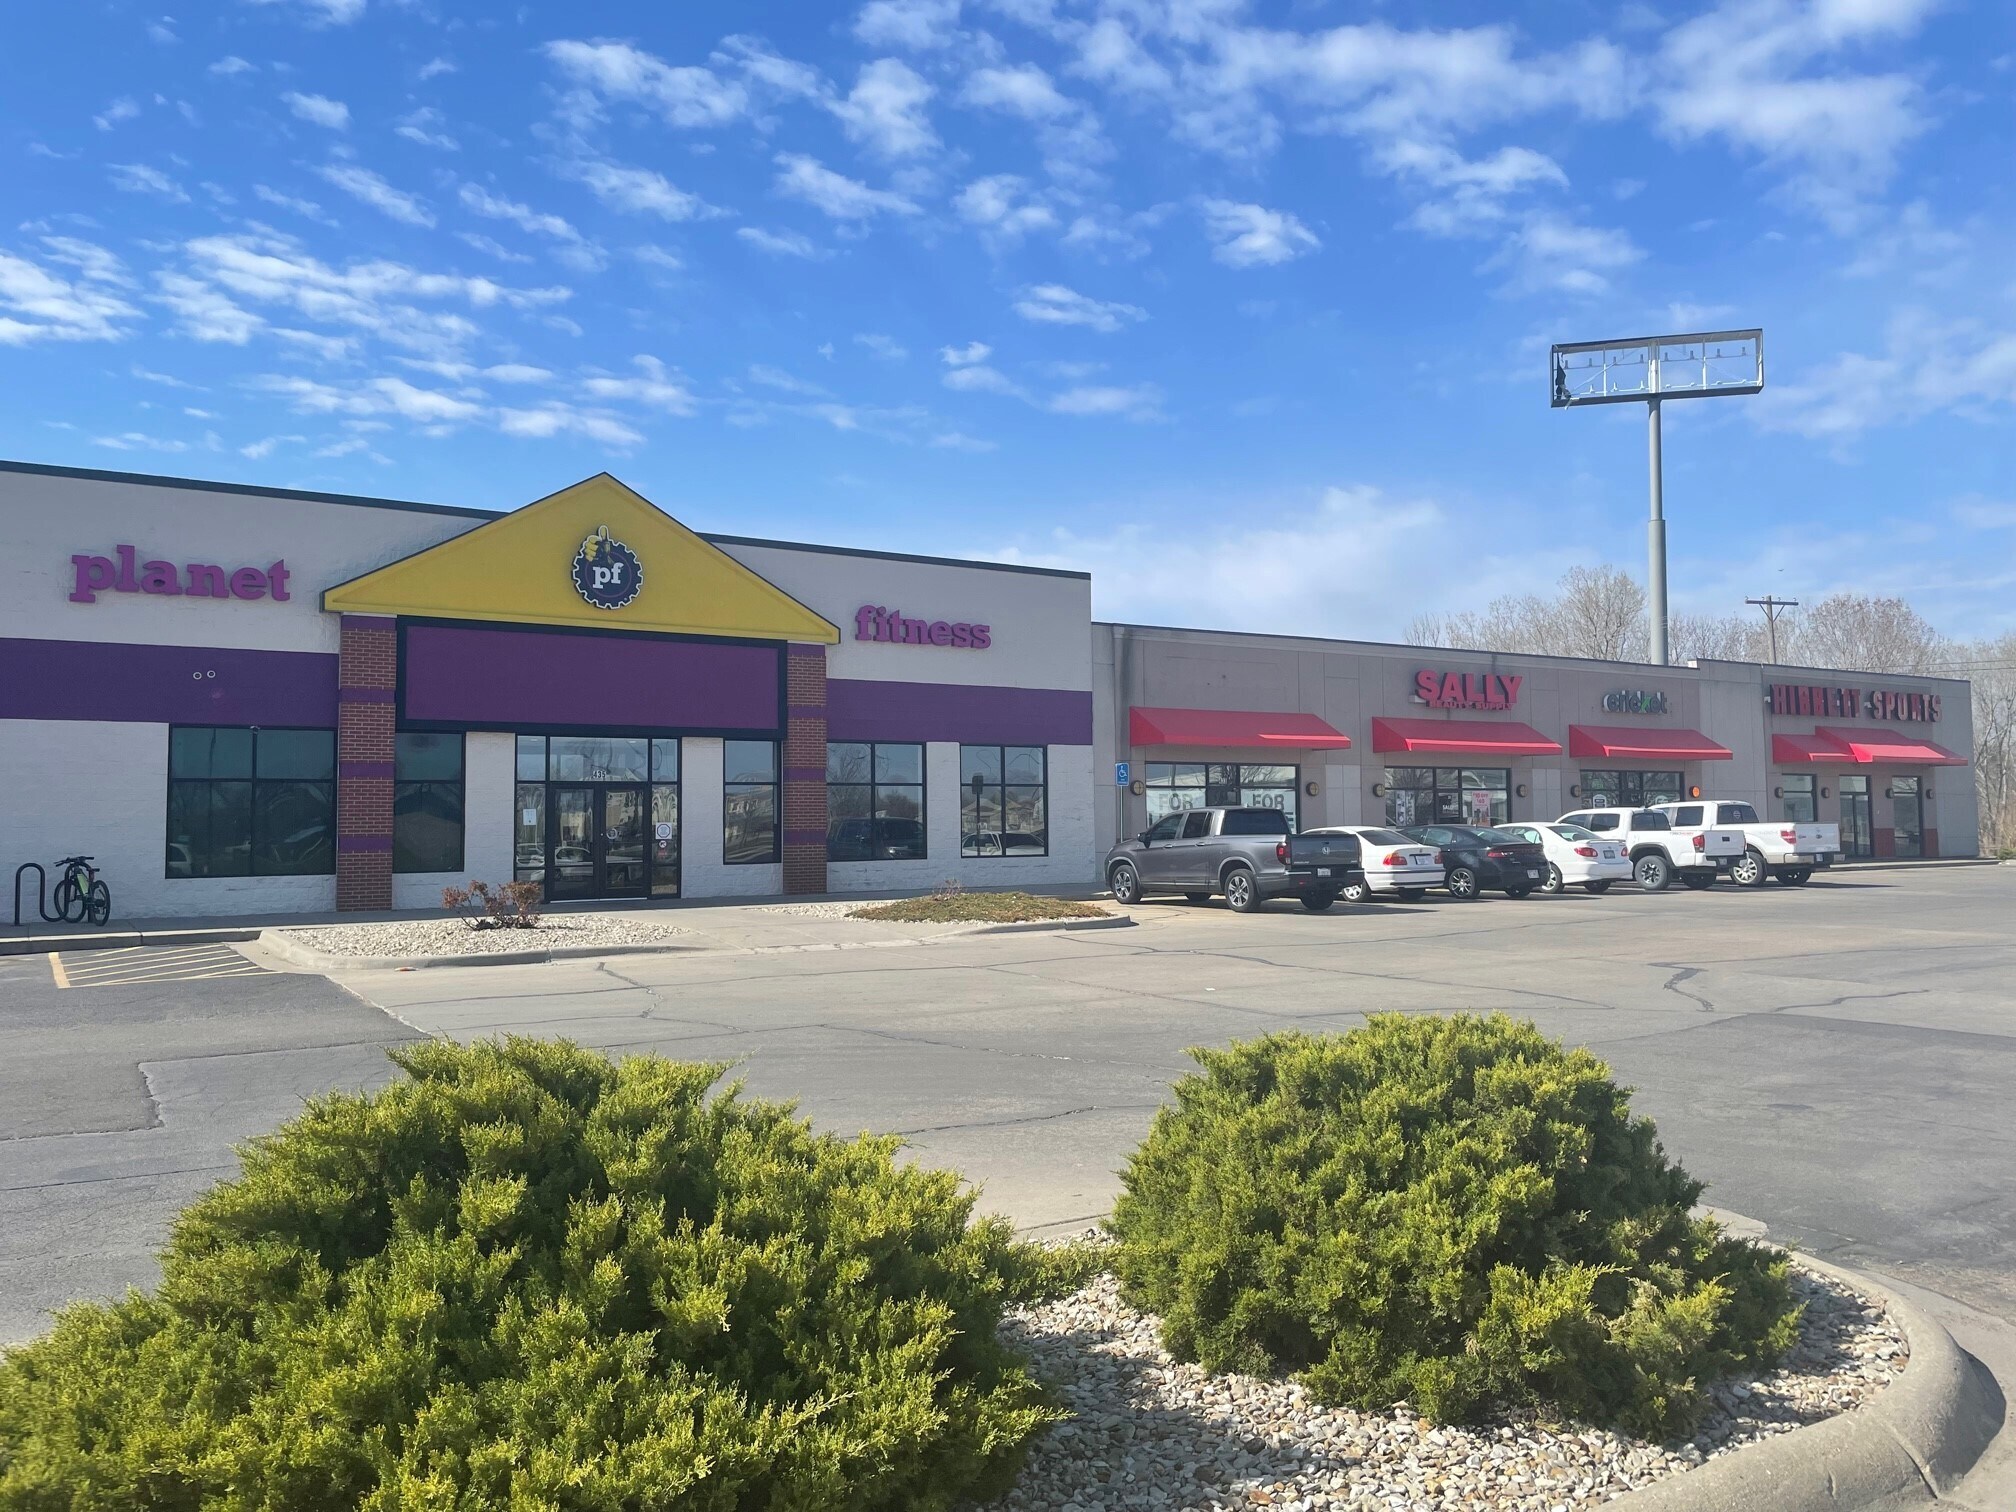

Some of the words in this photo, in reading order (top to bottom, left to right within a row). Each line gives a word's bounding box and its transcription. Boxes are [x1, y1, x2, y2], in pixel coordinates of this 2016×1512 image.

[69, 544, 290, 603] planet
[593, 562, 624, 589] pf
[855, 605, 992, 649] fitness
[1415, 669, 1522, 703] SALLY
[1771, 684, 1861, 718] HIBBETT
[1871, 691, 1942, 723] SPORTS
[1158, 793, 1194, 811] FOR
[1252, 793, 1285, 811] FOR
